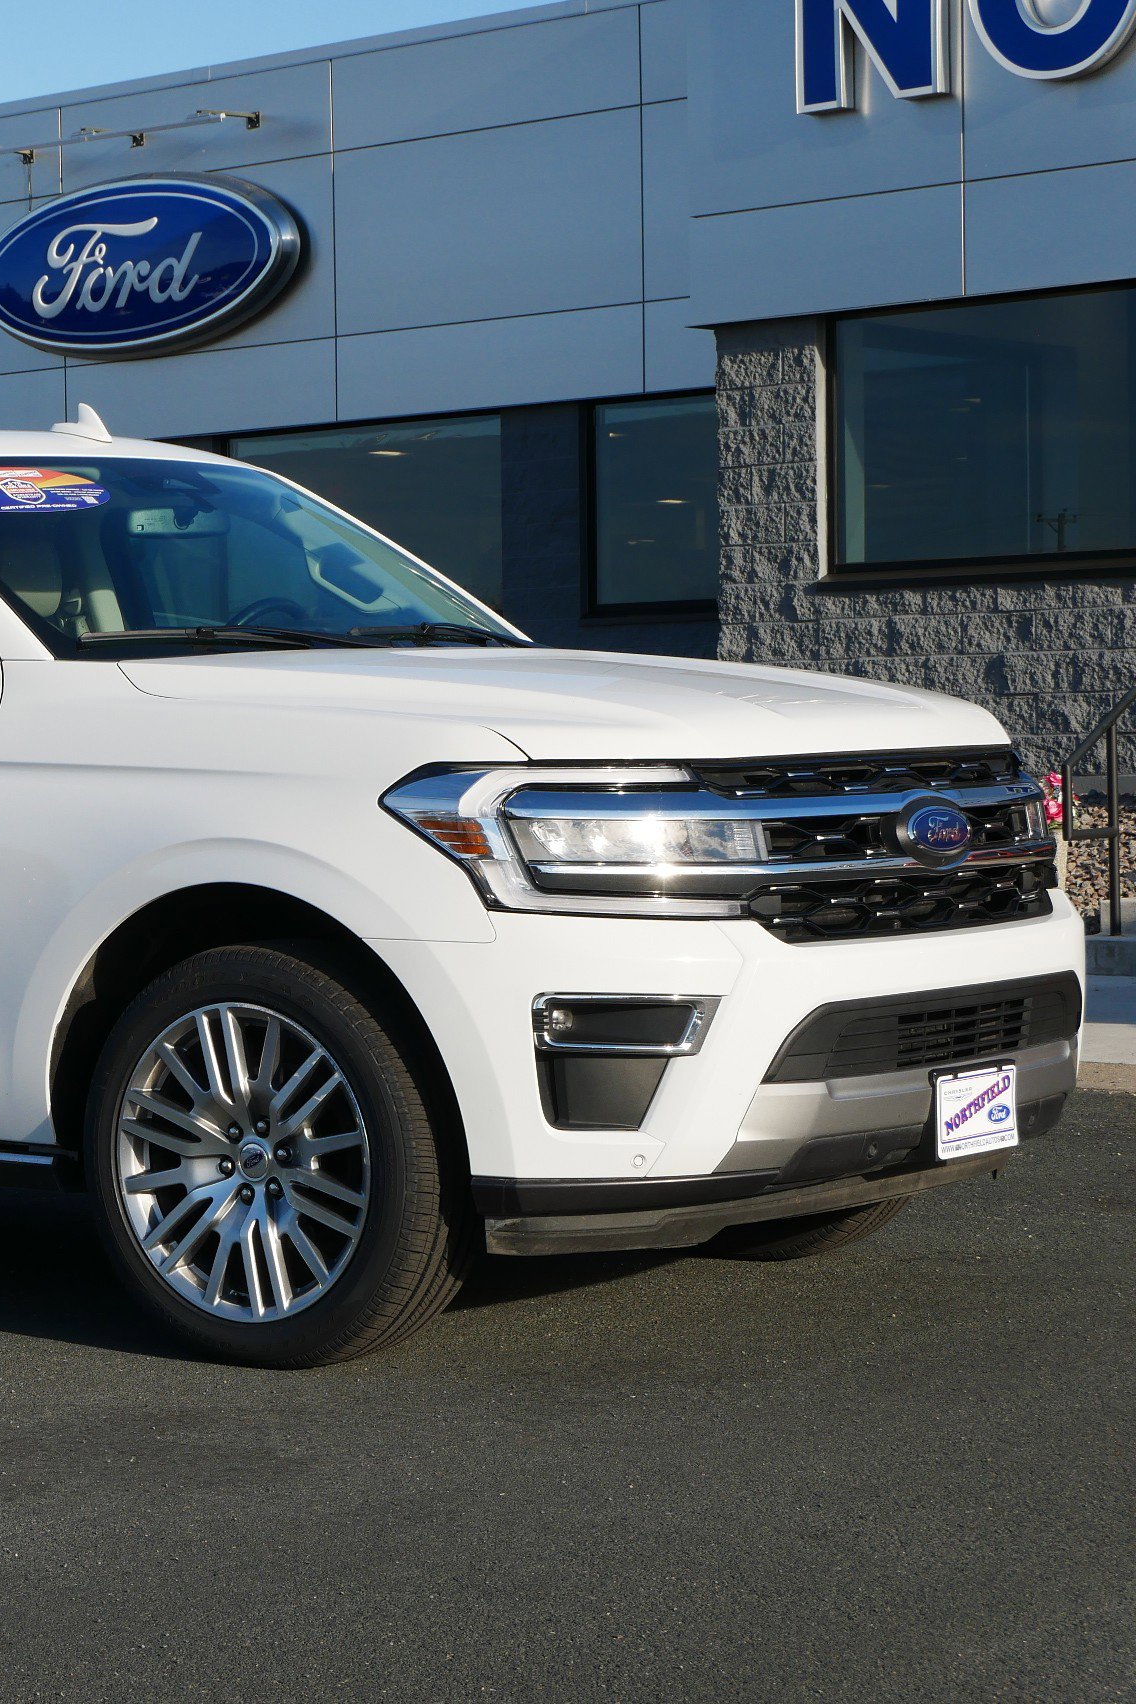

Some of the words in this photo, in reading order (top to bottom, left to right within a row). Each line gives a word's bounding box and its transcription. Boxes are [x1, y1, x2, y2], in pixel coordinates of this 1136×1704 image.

[32, 216, 203, 319] Ford
[928, 816, 960, 842] Ford
[944, 1075, 1010, 1136] NORTHFIELD
[991, 1106, 1006, 1120] Ford
